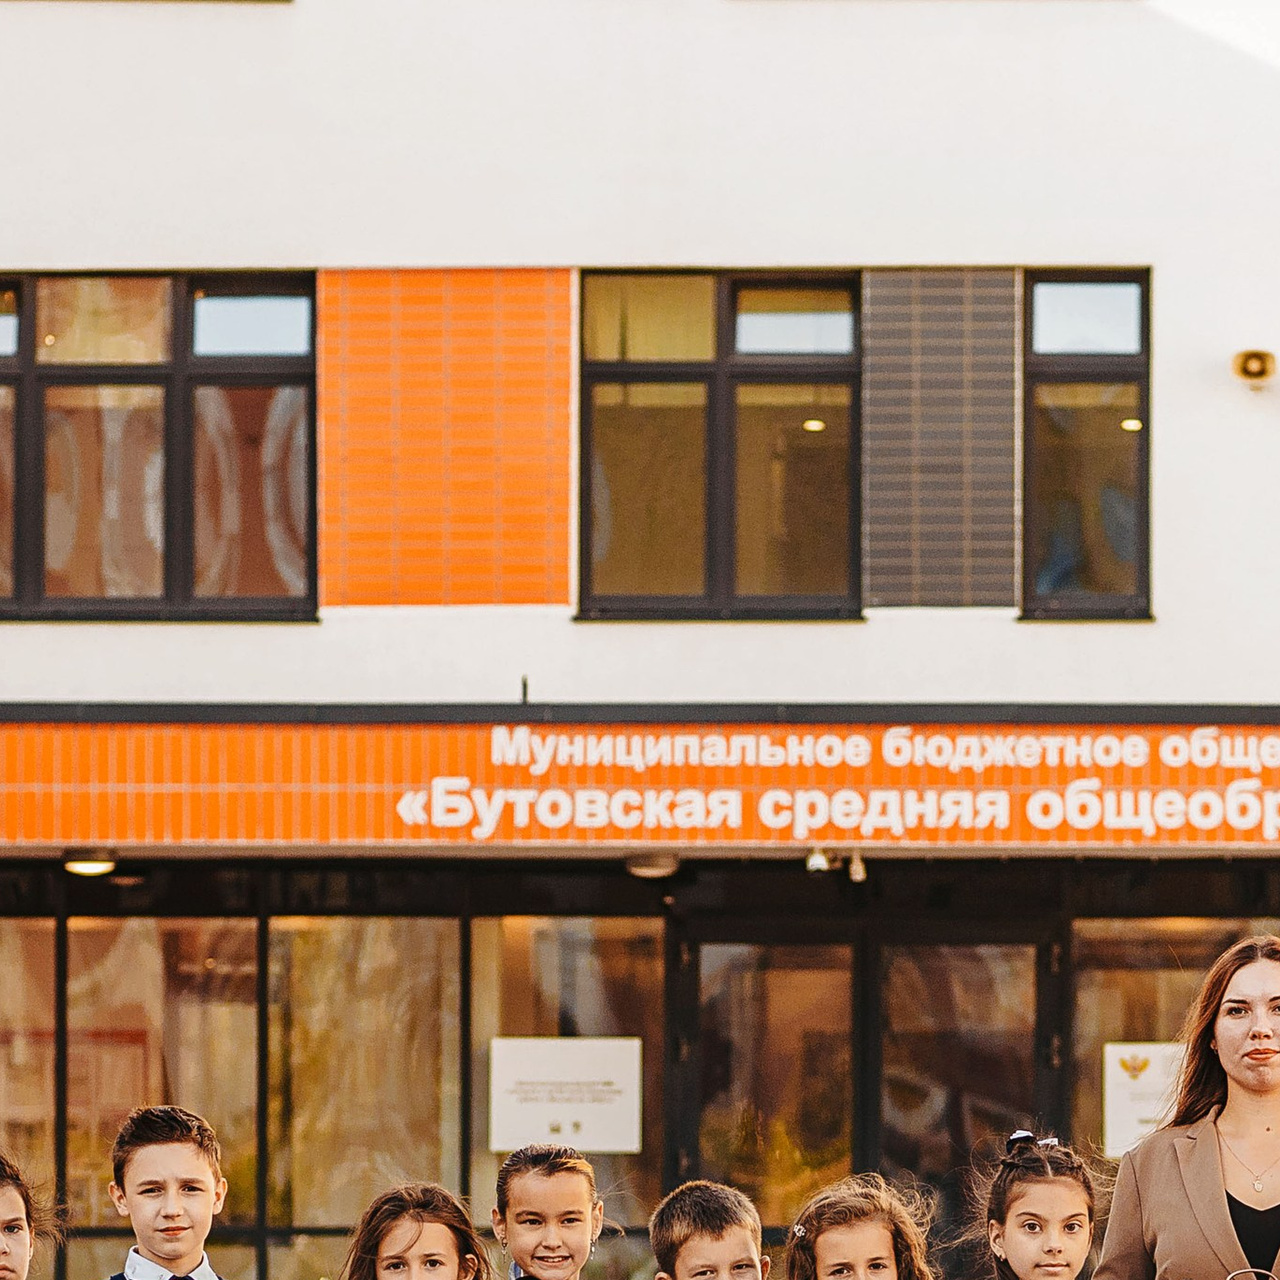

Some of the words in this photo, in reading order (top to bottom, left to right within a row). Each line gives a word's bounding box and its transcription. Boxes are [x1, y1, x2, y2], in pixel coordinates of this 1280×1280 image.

[491, 727, 871, 775] Муниципальное
[882, 727, 1148, 773] бюджетное
[396, 776, 741, 840] «Бутовская
[758, 787, 1010, 838] средняя
